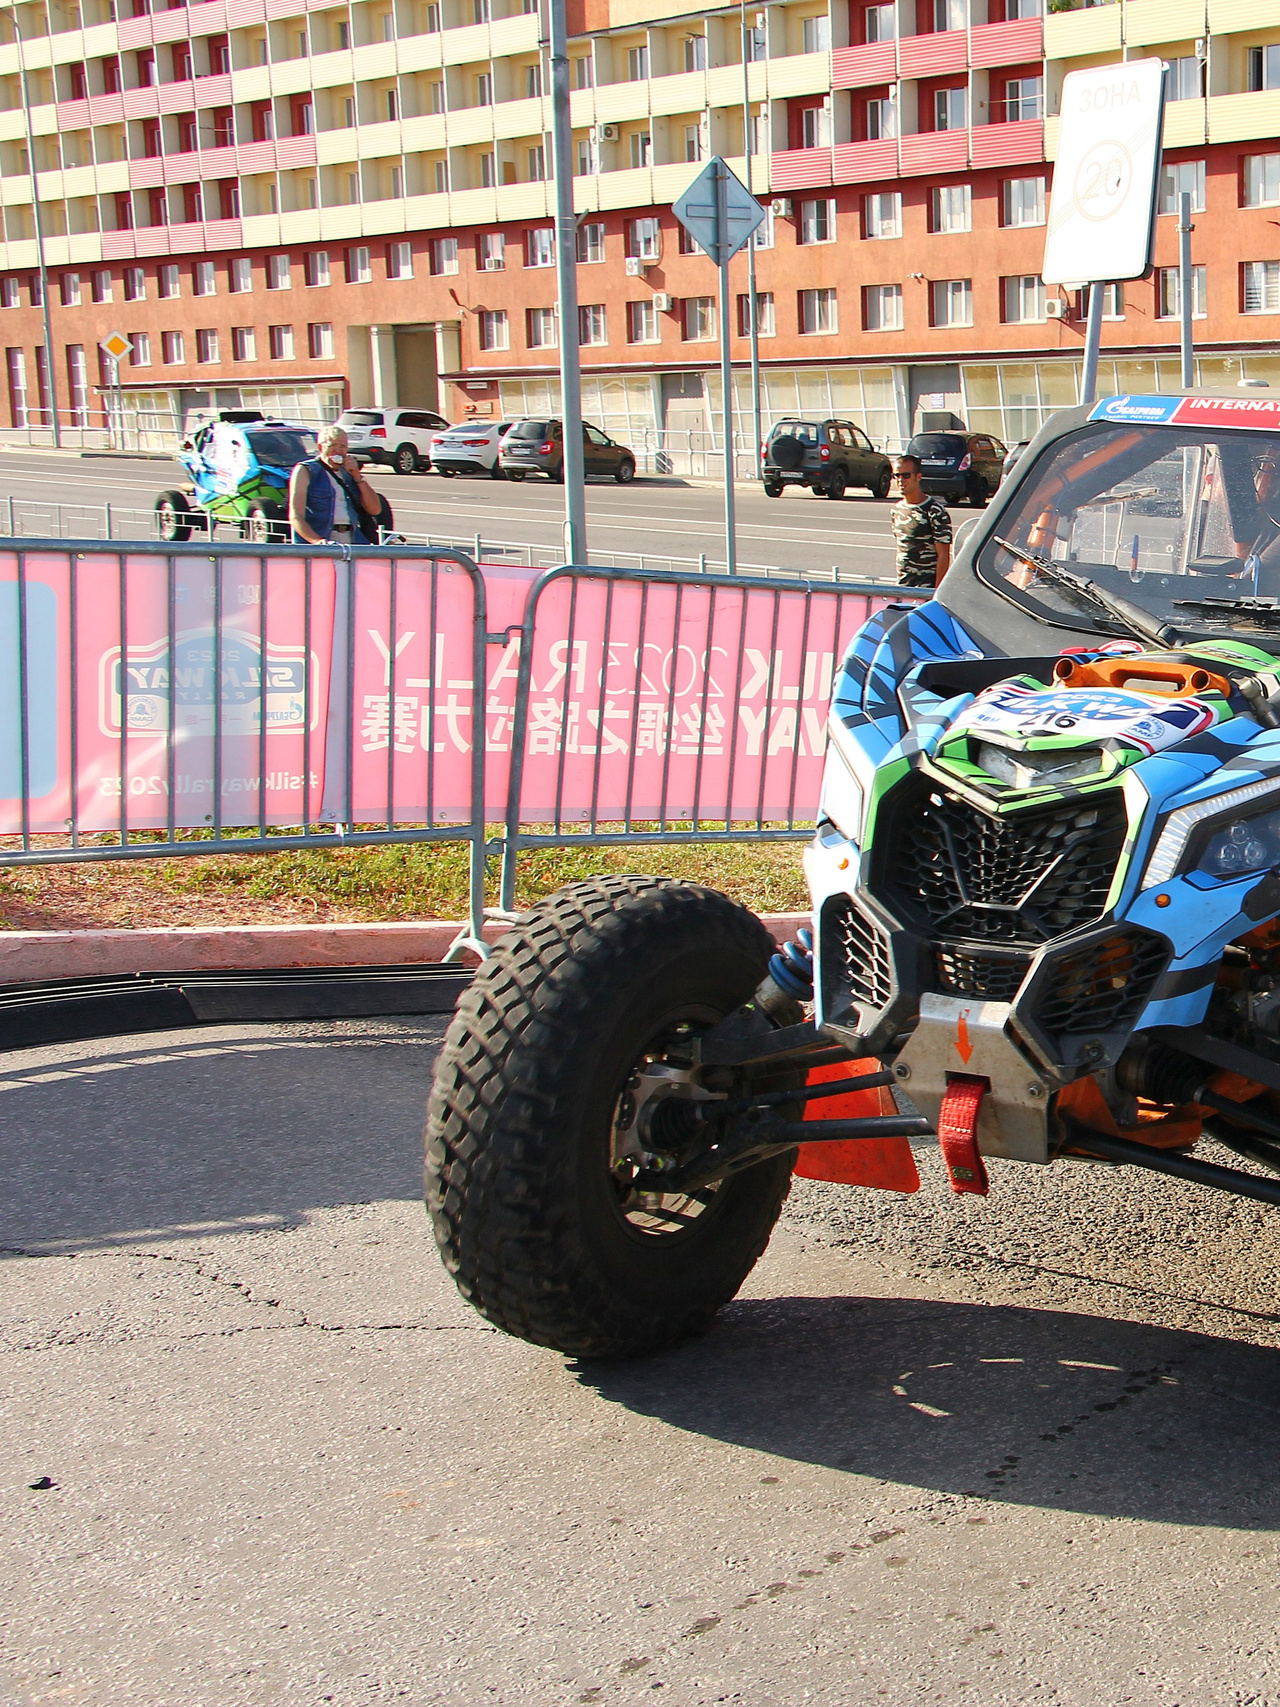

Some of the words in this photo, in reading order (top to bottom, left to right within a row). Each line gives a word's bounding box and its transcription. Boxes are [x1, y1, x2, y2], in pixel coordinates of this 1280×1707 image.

[1080, 80, 1141, 113] ЗОНА
[1083, 158, 1122, 201] 20
[1053, 694, 1124, 704] 2023
